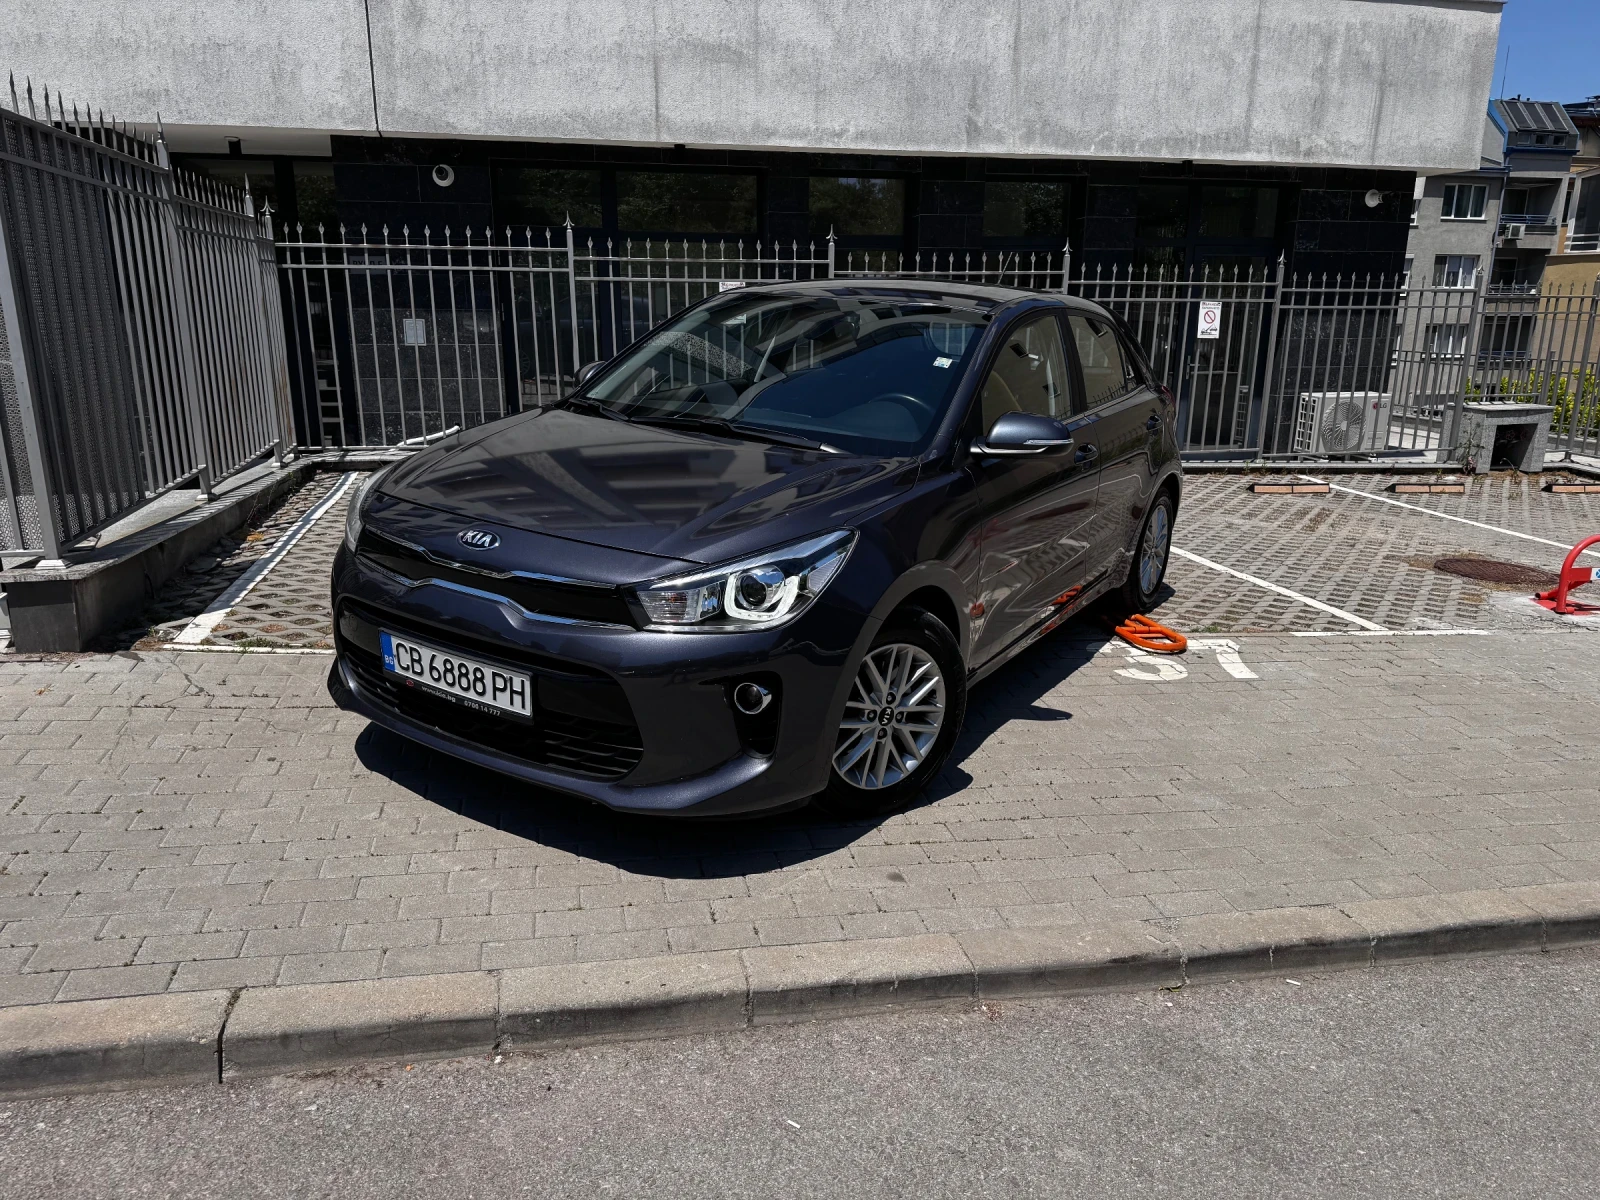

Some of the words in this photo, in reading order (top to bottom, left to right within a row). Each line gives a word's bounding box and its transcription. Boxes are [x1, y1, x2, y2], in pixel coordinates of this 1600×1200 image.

[462, 530, 492, 547] KIA
[384, 654, 394, 665] BG
[395, 642, 425, 676] CB
[429, 654, 486, 697] 6888
[491, 671, 526, 710] PH
[881, 708, 892, 724] KIA
